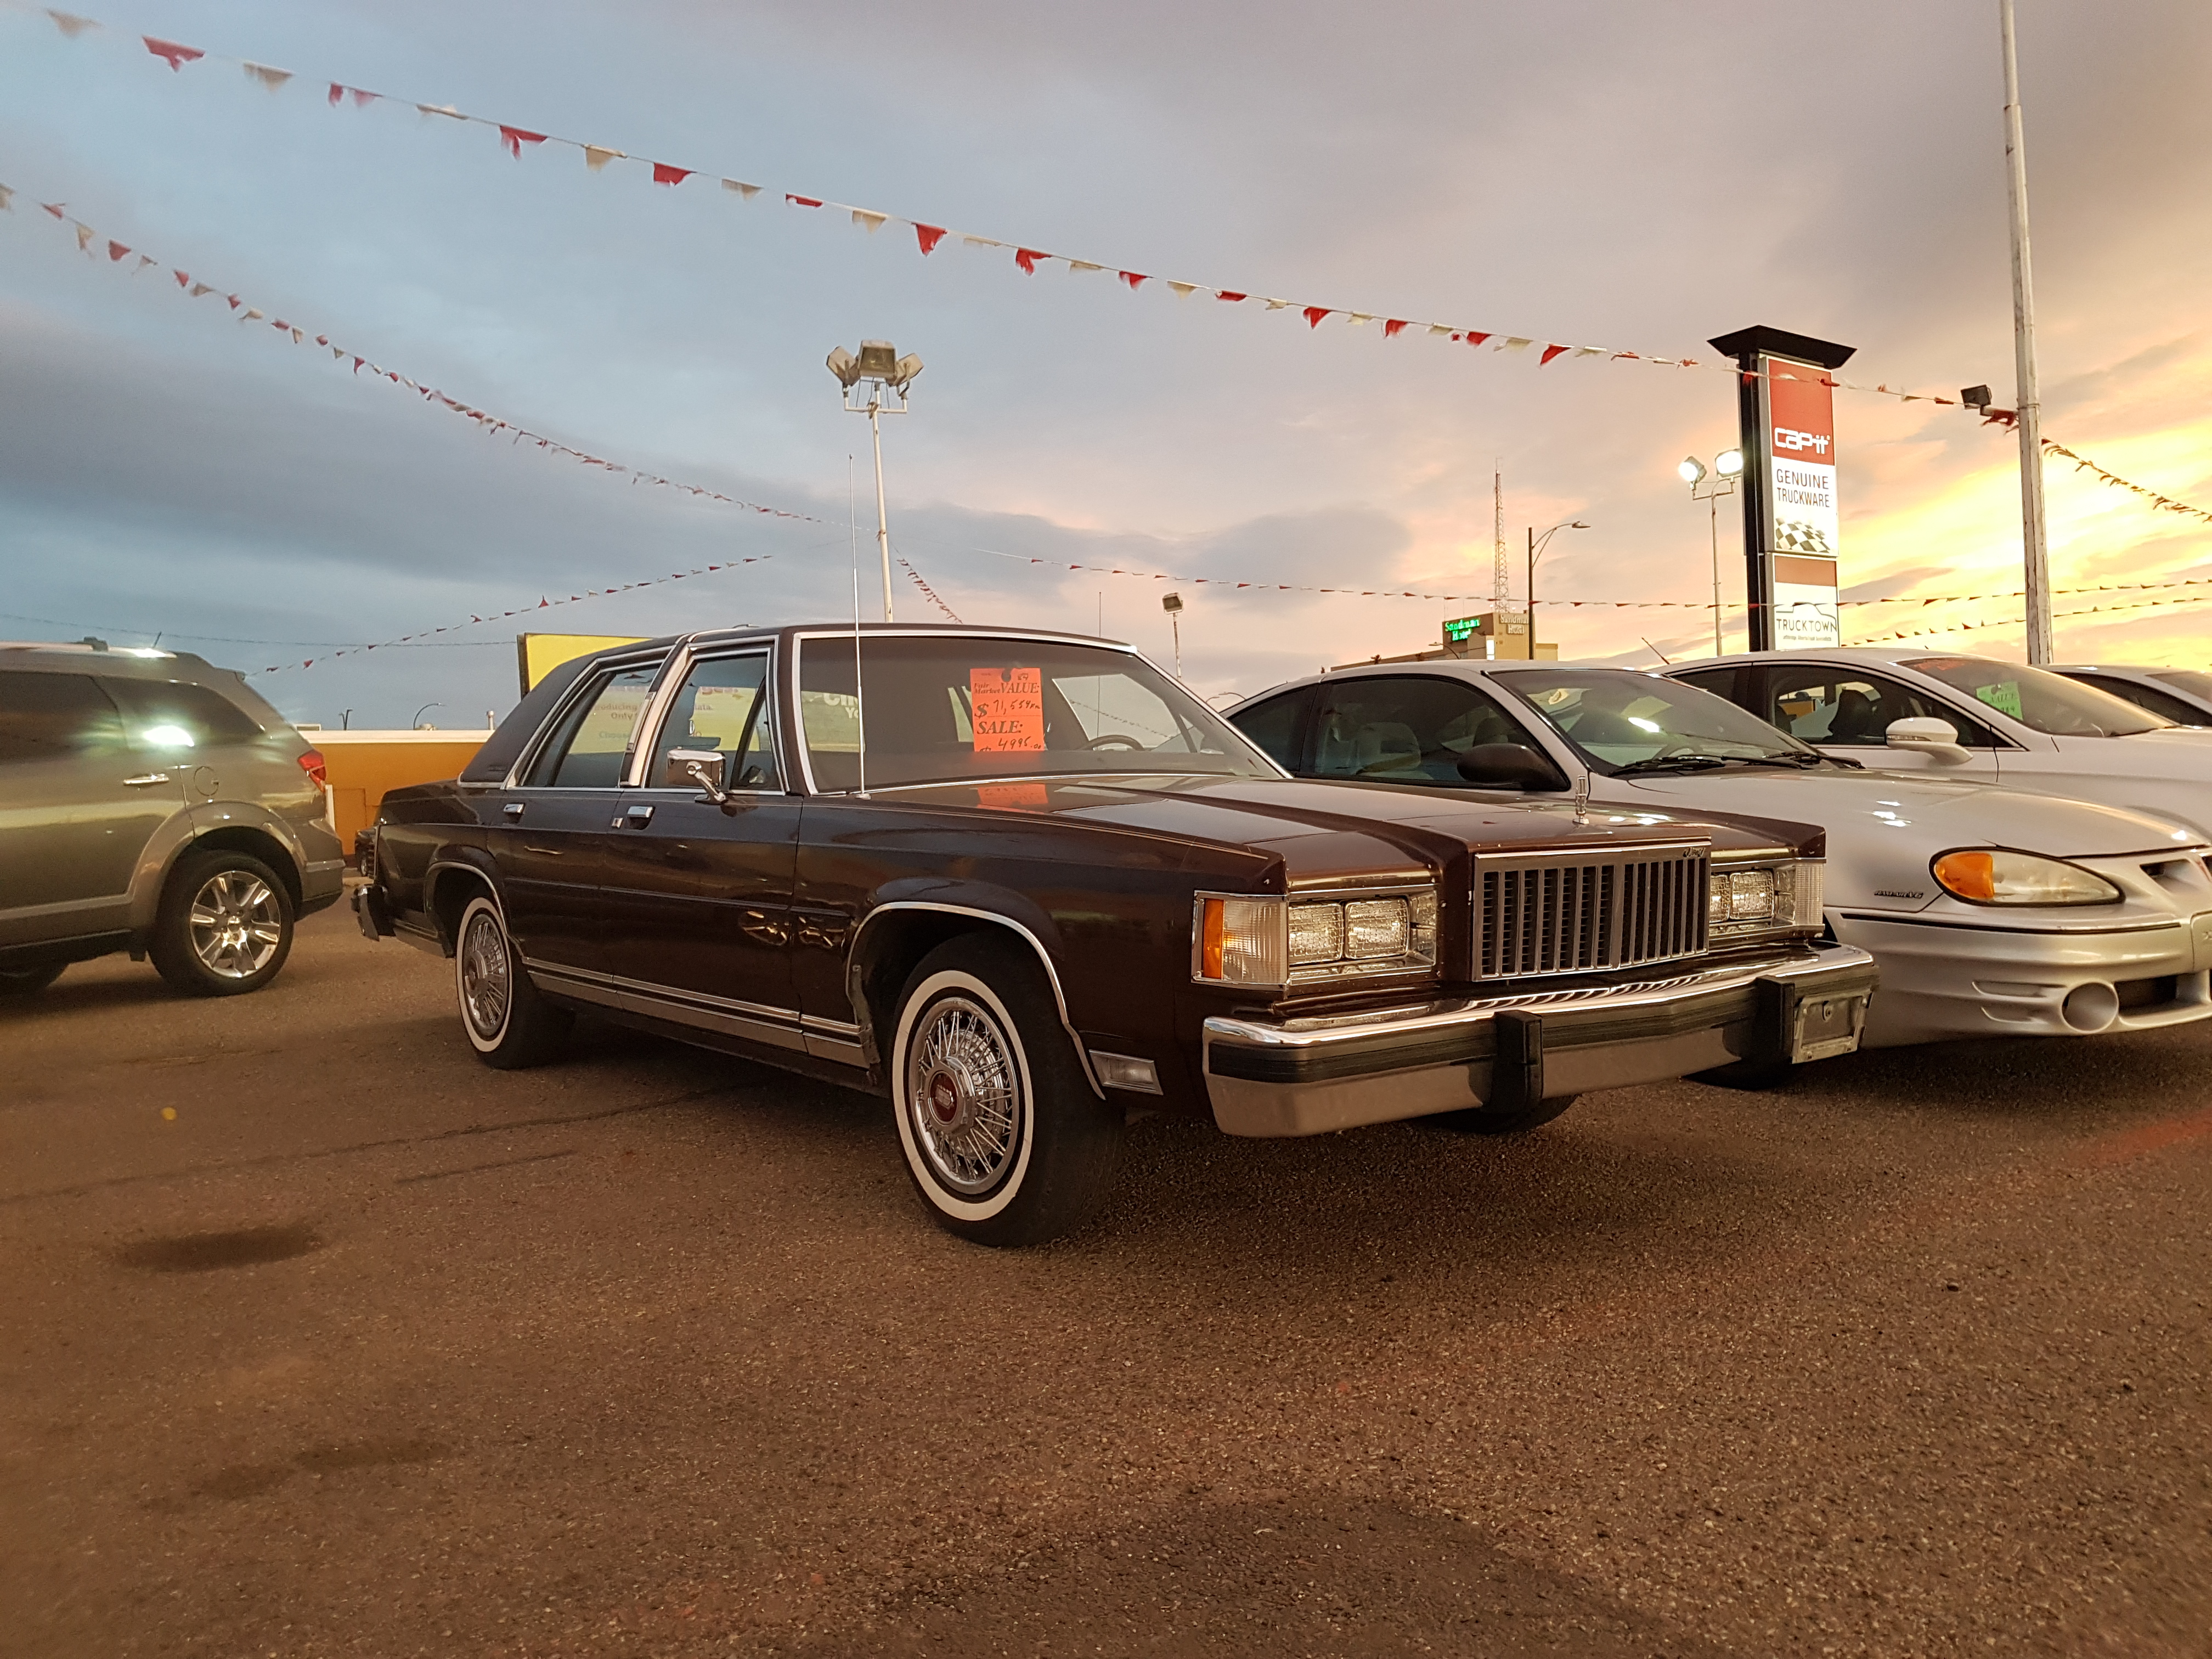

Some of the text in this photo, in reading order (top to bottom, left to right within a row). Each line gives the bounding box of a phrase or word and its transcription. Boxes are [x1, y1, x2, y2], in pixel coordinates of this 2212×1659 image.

[1776, 469, 1829, 489] GENUINE
[1777, 487, 1830, 507] TRUCKWARE
[1445, 618, 1480, 631] Sandman
[1452, 628, 1472, 641] Hotel
[611, 712, 633, 720] Only
[974, 703, 989, 718] $
[977, 720, 1023, 734] SALE:
